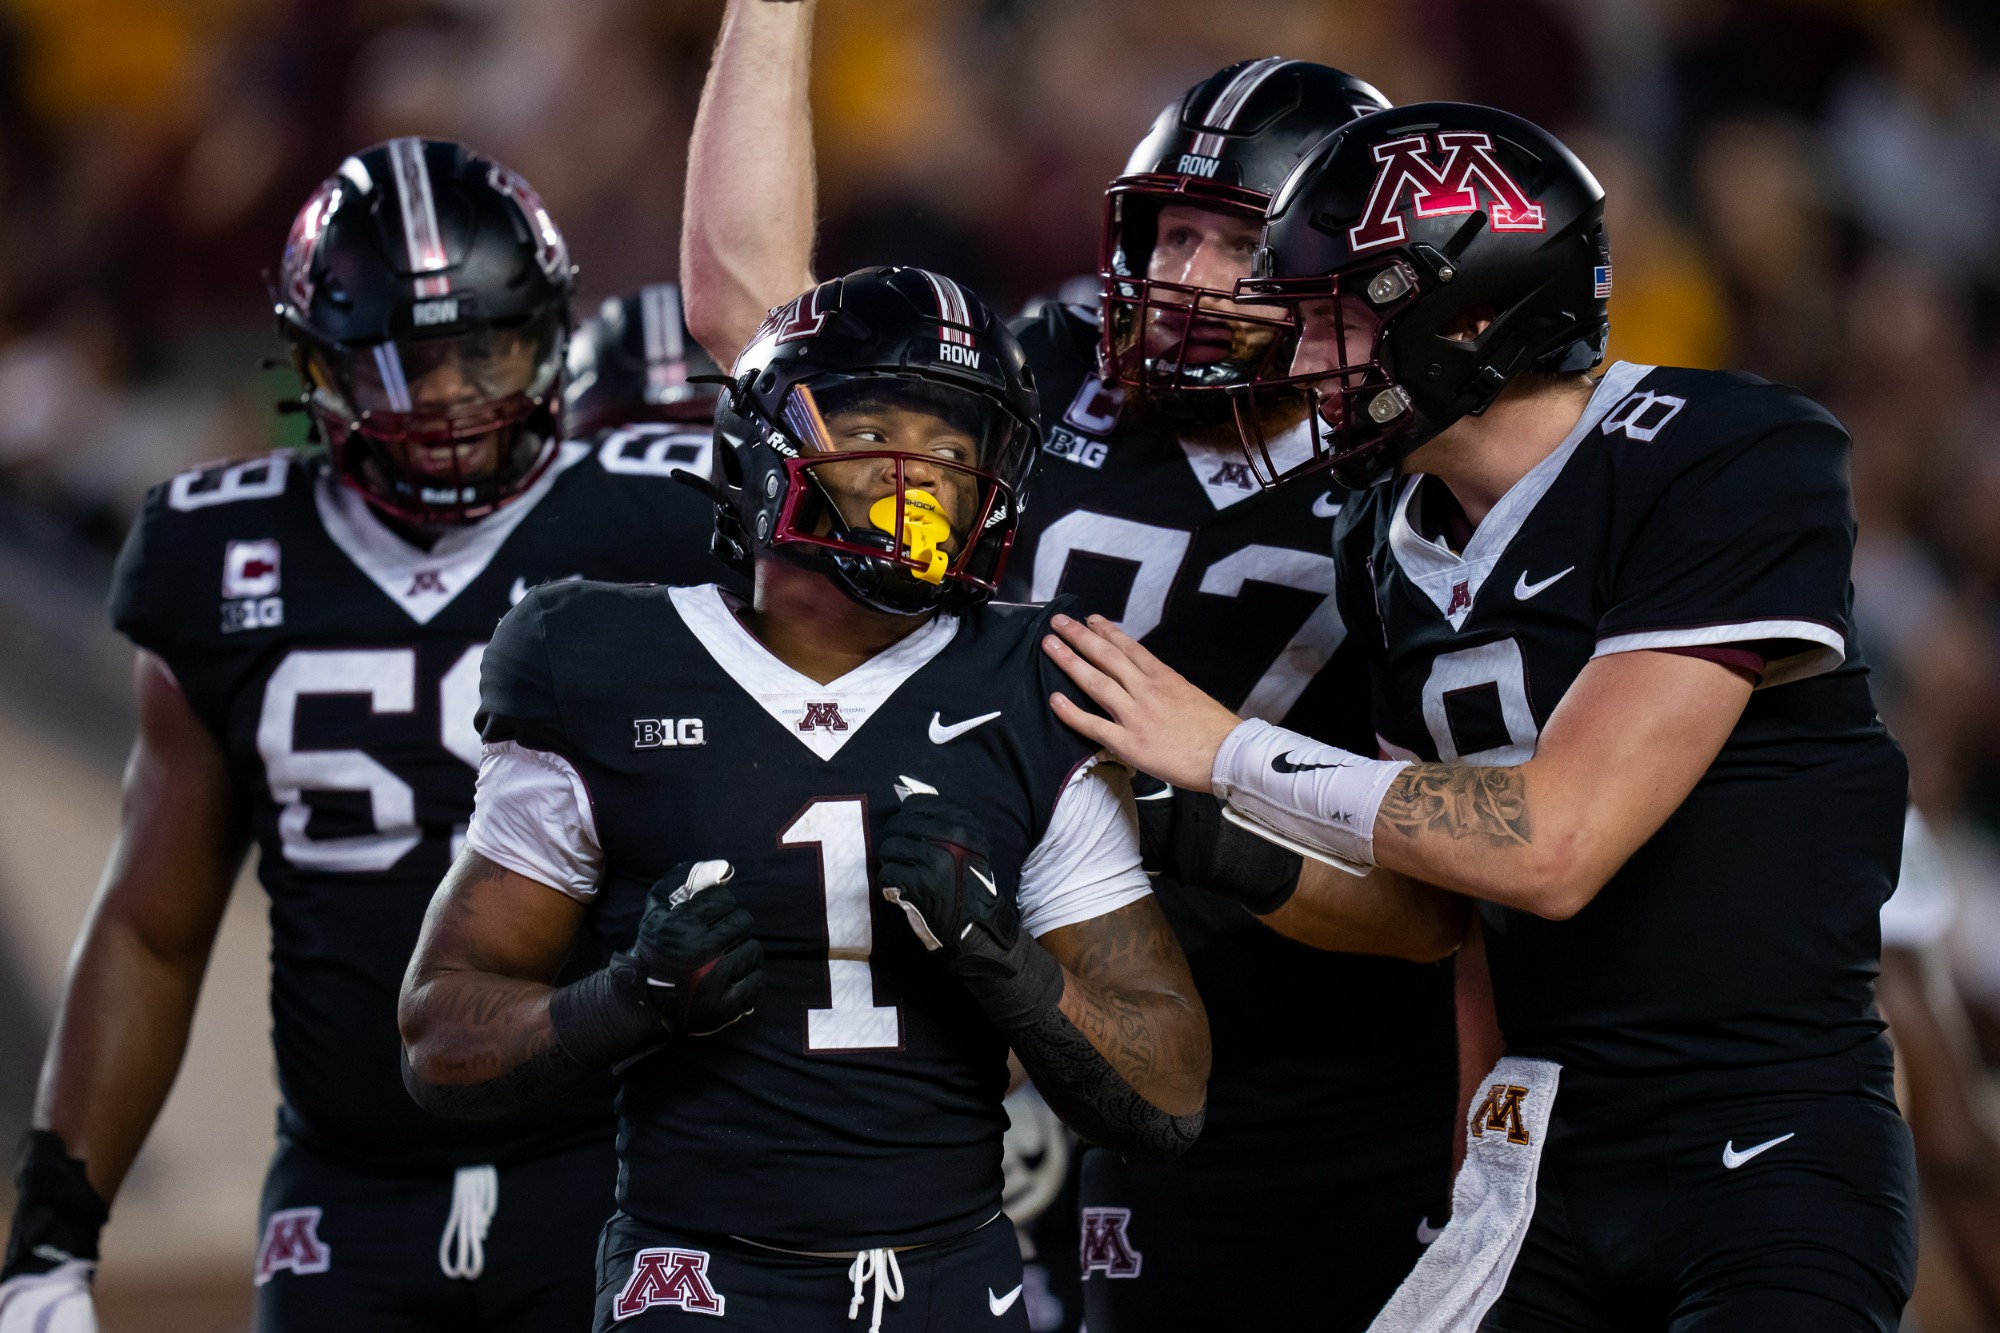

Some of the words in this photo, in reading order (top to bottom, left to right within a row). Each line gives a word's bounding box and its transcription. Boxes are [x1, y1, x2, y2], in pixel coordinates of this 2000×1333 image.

[1177, 154, 1220, 178] ROW
[1348, 130, 1546, 252] M
[940, 343, 980, 370] ROW
[1601, 389, 1686, 442] 8
[1208, 461, 1253, 490] M
[227, 543, 280, 597] C
[406, 571, 448, 598] M
[800, 702, 849, 732] M
[1331, 810, 1353, 825] AK
[779, 797, 902, 1052] 1
[1470, 1084, 1529, 1145] M
[257, 1211, 327, 1281] M
[615, 1249, 723, 1319] M
